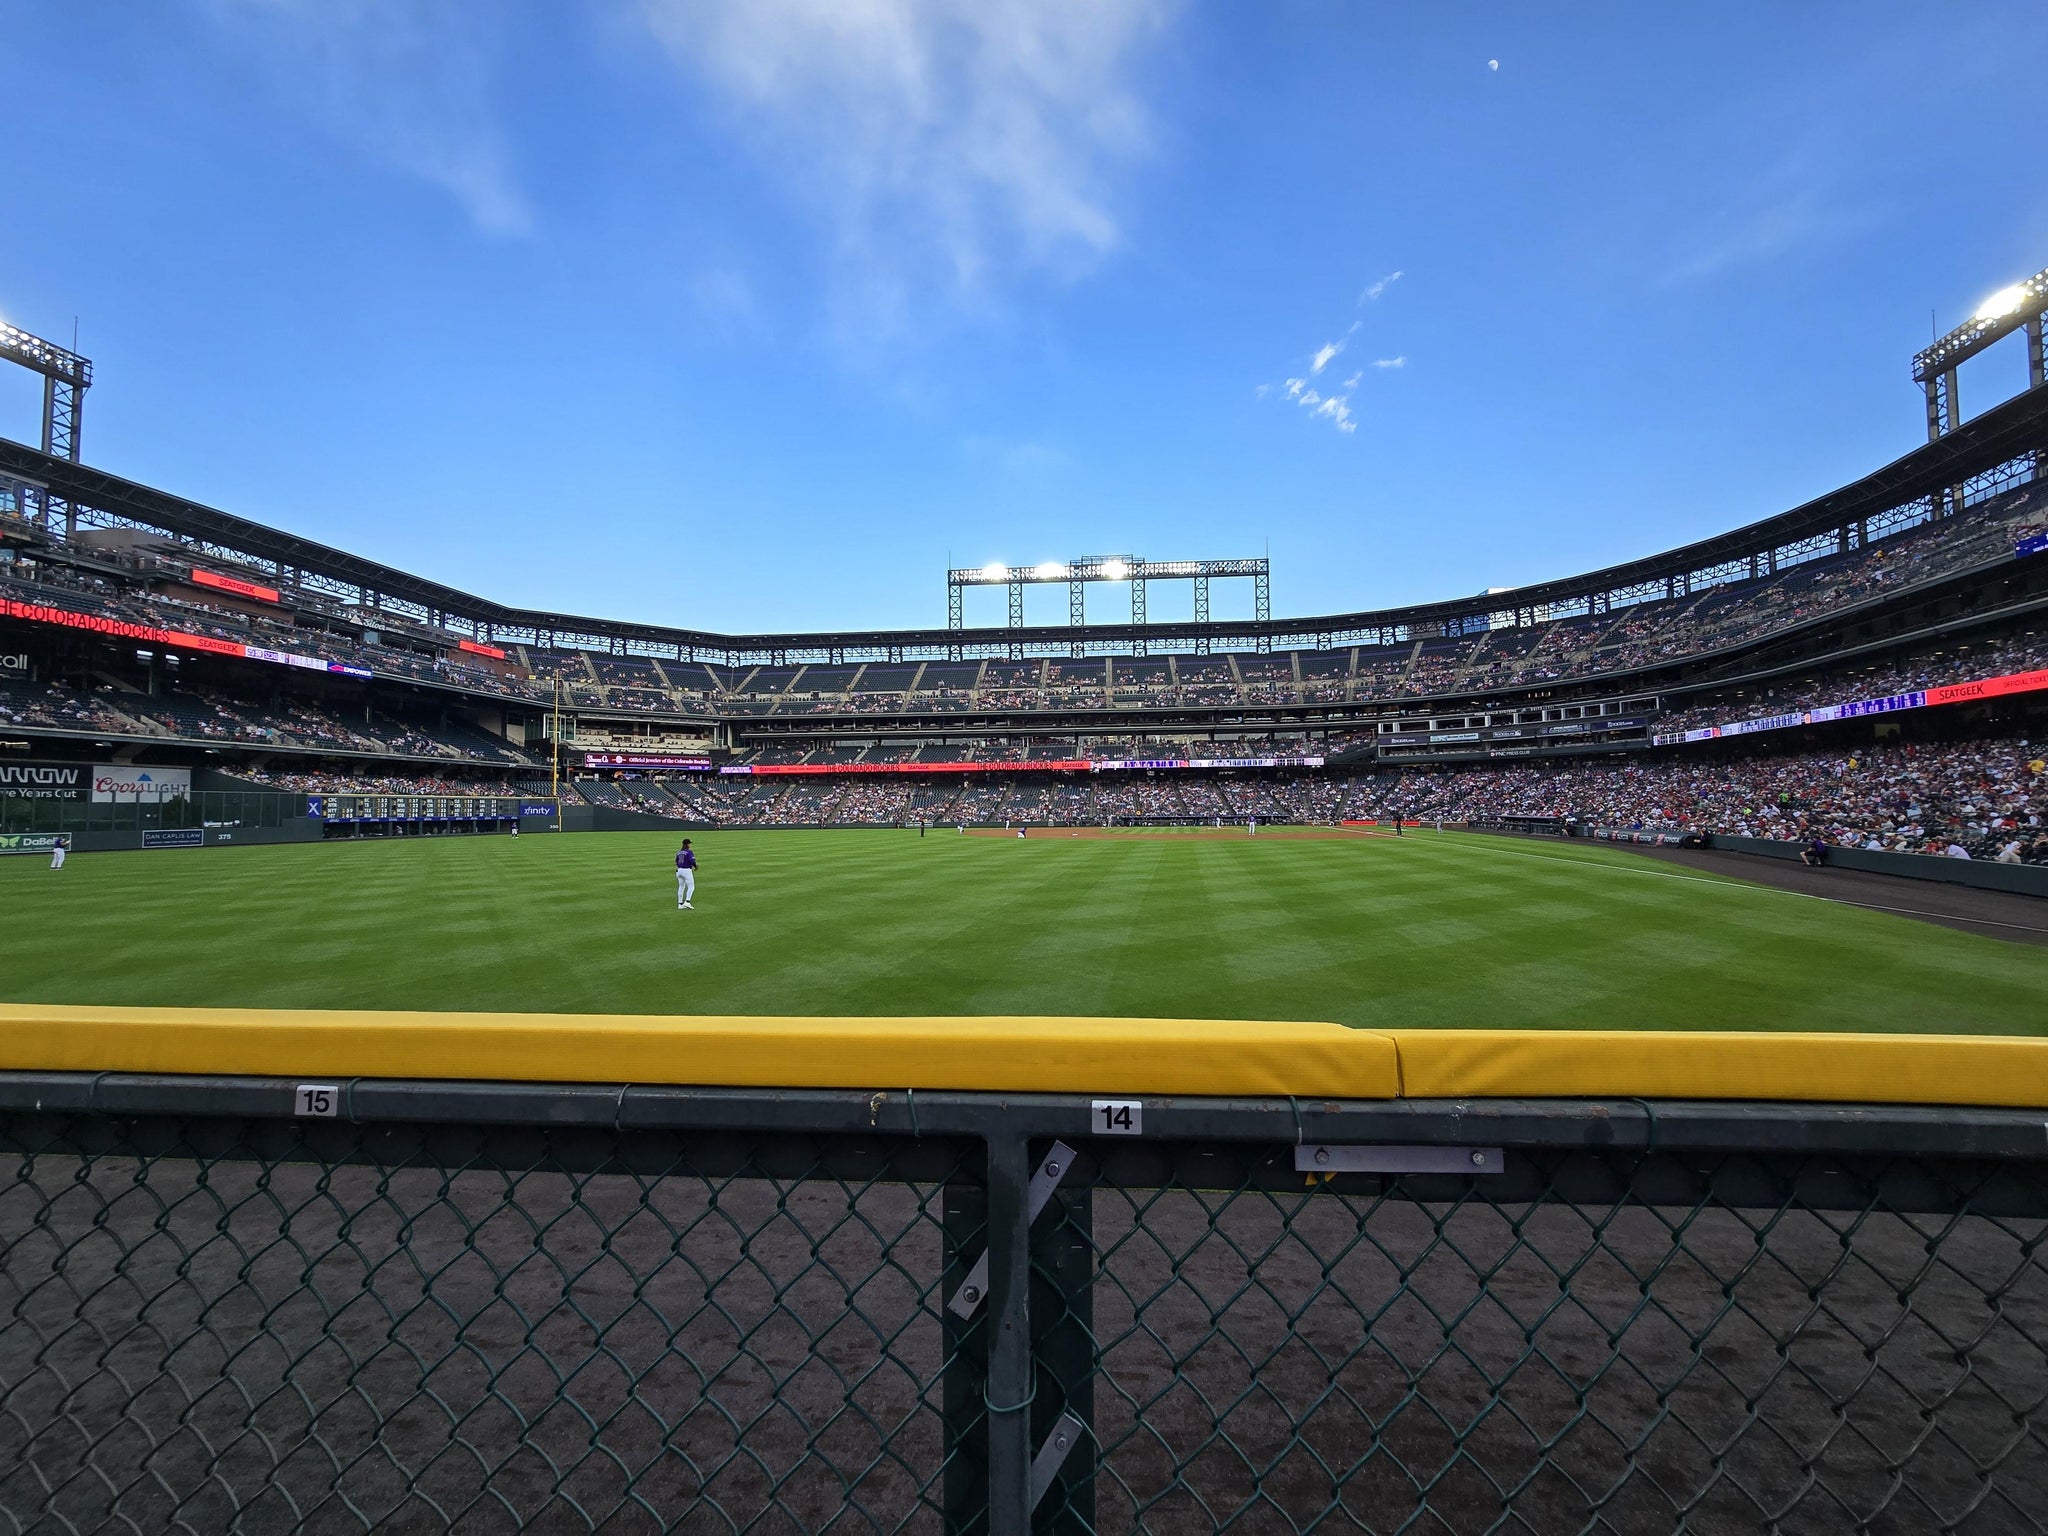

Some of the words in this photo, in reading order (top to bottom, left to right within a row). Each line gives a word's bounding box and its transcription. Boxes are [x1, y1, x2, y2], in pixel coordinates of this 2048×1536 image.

[218, 578, 256, 594] SEATGEEK
[21, 603, 109, 633] COLORADO
[112, 621, 170, 643] ROCKIES
[199, 638, 238, 653] SEATGEEK
[0, 654, 28, 670] all
[1939, 683, 1985, 701] SEATGEEK
[19, 788, 53, 798] Years
[96, 777, 144, 793] Coors
[147, 783, 188, 793] LIGHT
[524, 806, 550, 816] xfinity
[303, 1089, 330, 1113] 15
[1100, 1105, 1133, 1130] 14
